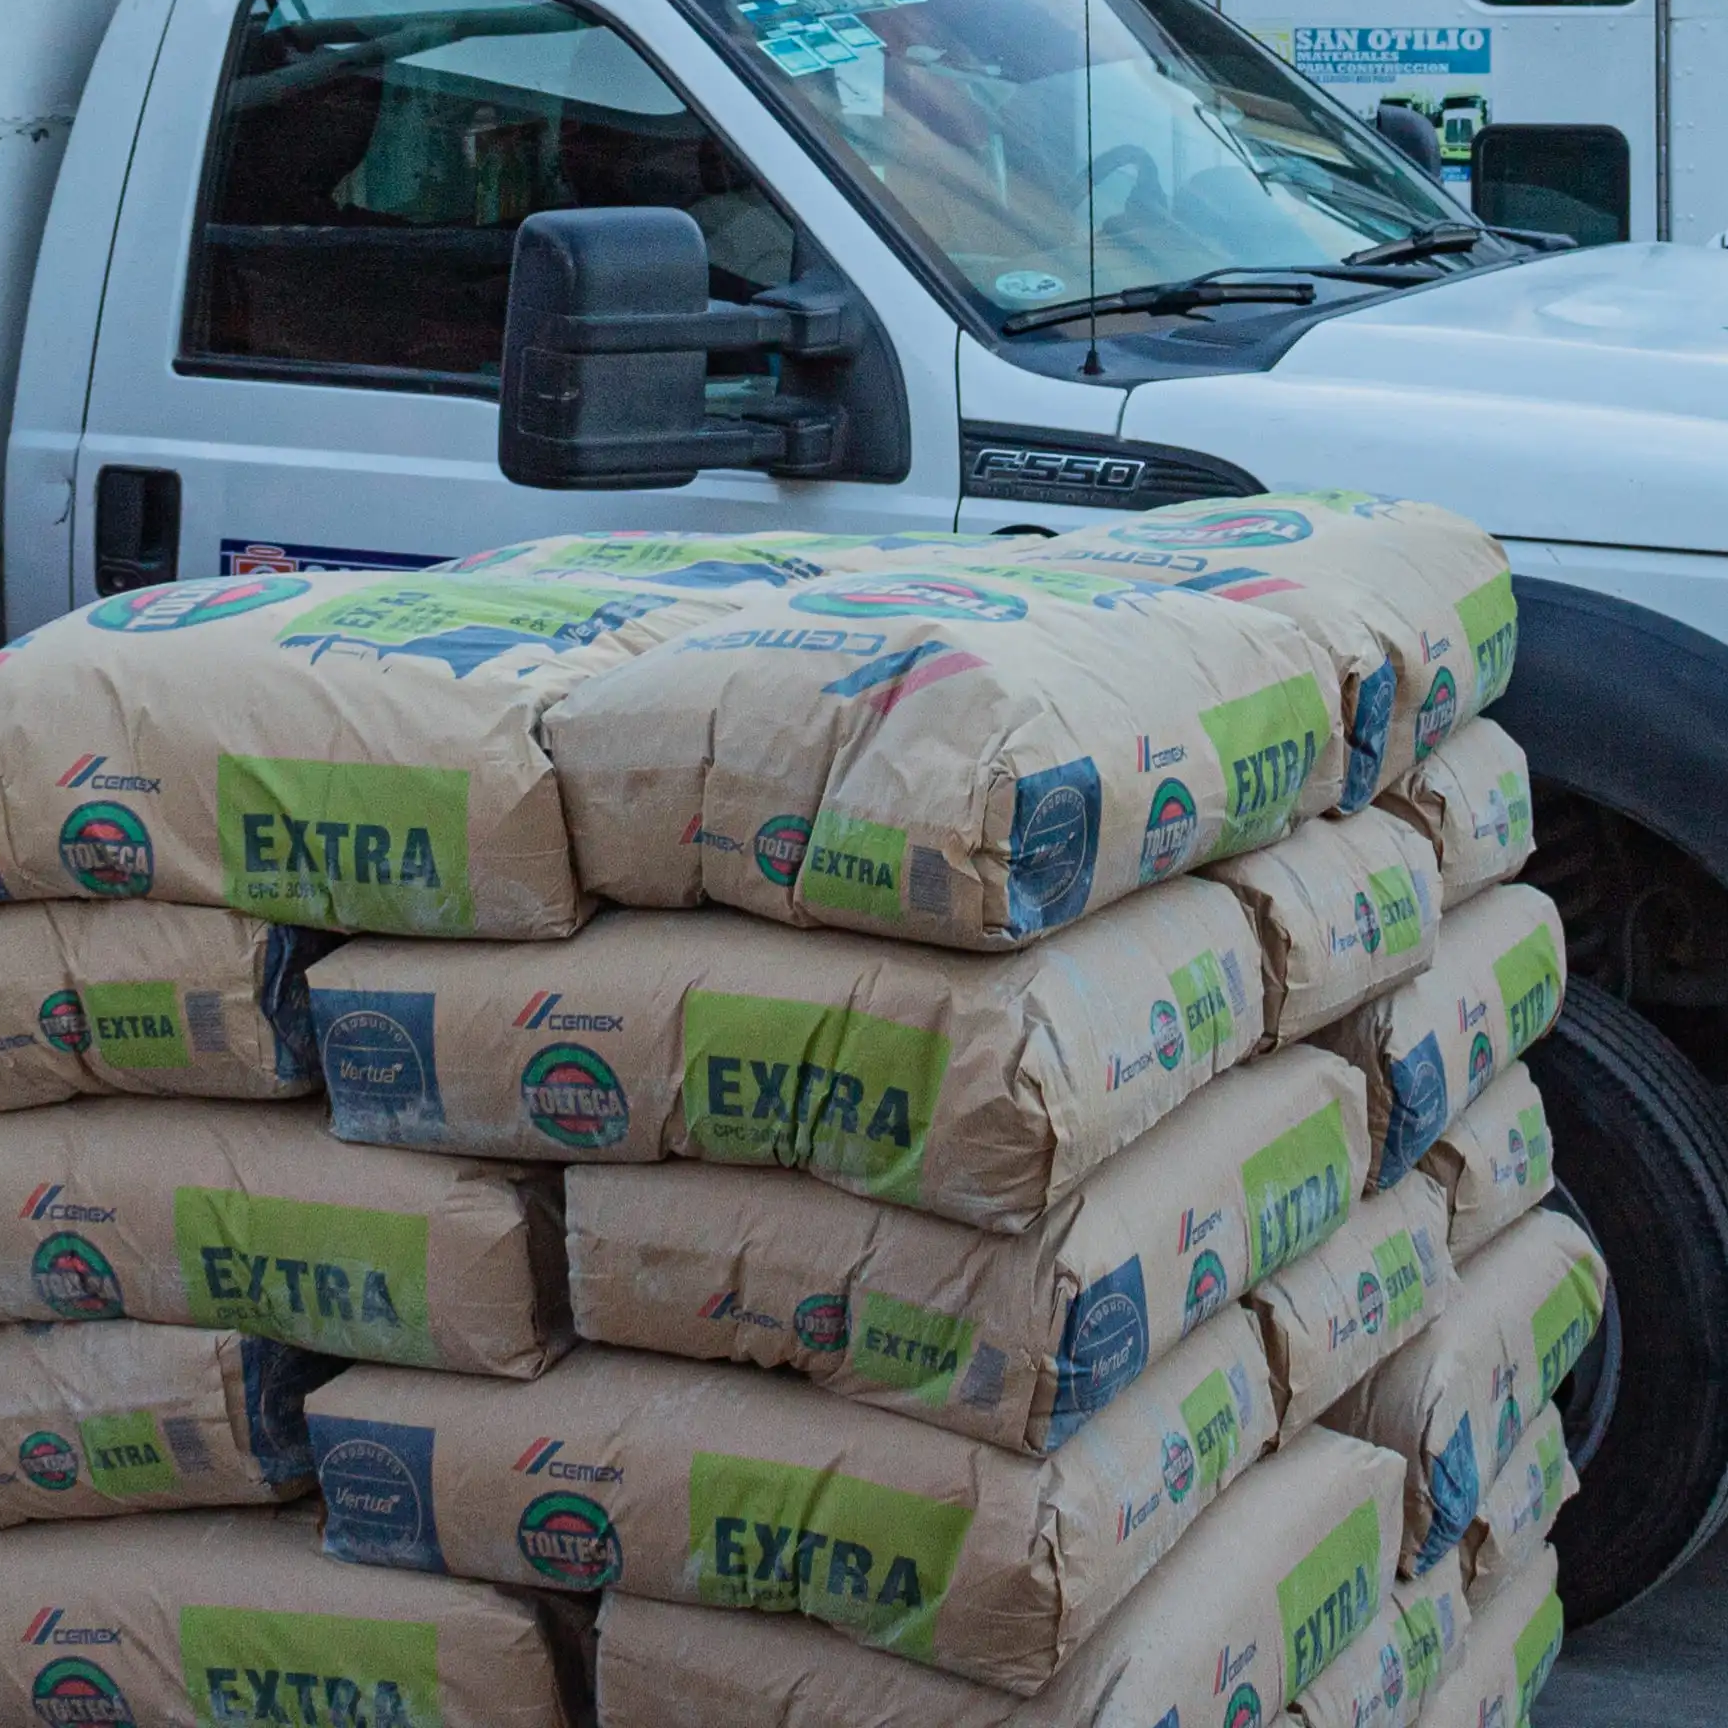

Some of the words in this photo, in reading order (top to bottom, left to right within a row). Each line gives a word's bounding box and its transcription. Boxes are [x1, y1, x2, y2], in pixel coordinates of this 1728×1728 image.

[1294, 28, 1360, 51] SAN
[1367, 28, 1486, 51] OTILIO
[1295, 51, 1400, 62] MATERIALES
[1296, 62, 1335, 73] PARA
[1337, 62, 1450, 73] CONSTRUCCION
[91, 772, 162, 796] CEMEX
[1232, 729, 1318, 818] EXTRA
[240, 812, 442, 889] EXTRA
[810, 844, 894, 890] EXTRA
[95, 1014, 176, 1041] EXTRA
[548, 1014, 624, 1033] CEMEX
[338, 1060, 400, 1085] Vertua
[524, 1085, 624, 1119] TOLTECA
[707, 1054, 912, 1149] EXTRA
[50, 1204, 118, 1224] CEMEX
[1258, 1162, 1341, 1270] EXTRA
[200, 1245, 404, 1328] EXTRA
[865, 1325, 959, 1373] EXTRA
[1196, 1402, 1236, 1458] EXTRA
[548, 1460, 625, 1485] CEMEX
[334, 1485, 395, 1515] Vertua
[715, 1515, 923, 1609] EXTRA
[53, 1626, 123, 1646] CEMEX
[1293, 1565, 1370, 1688] EXTRA
[207, 1666, 414, 1728] EXTRA
